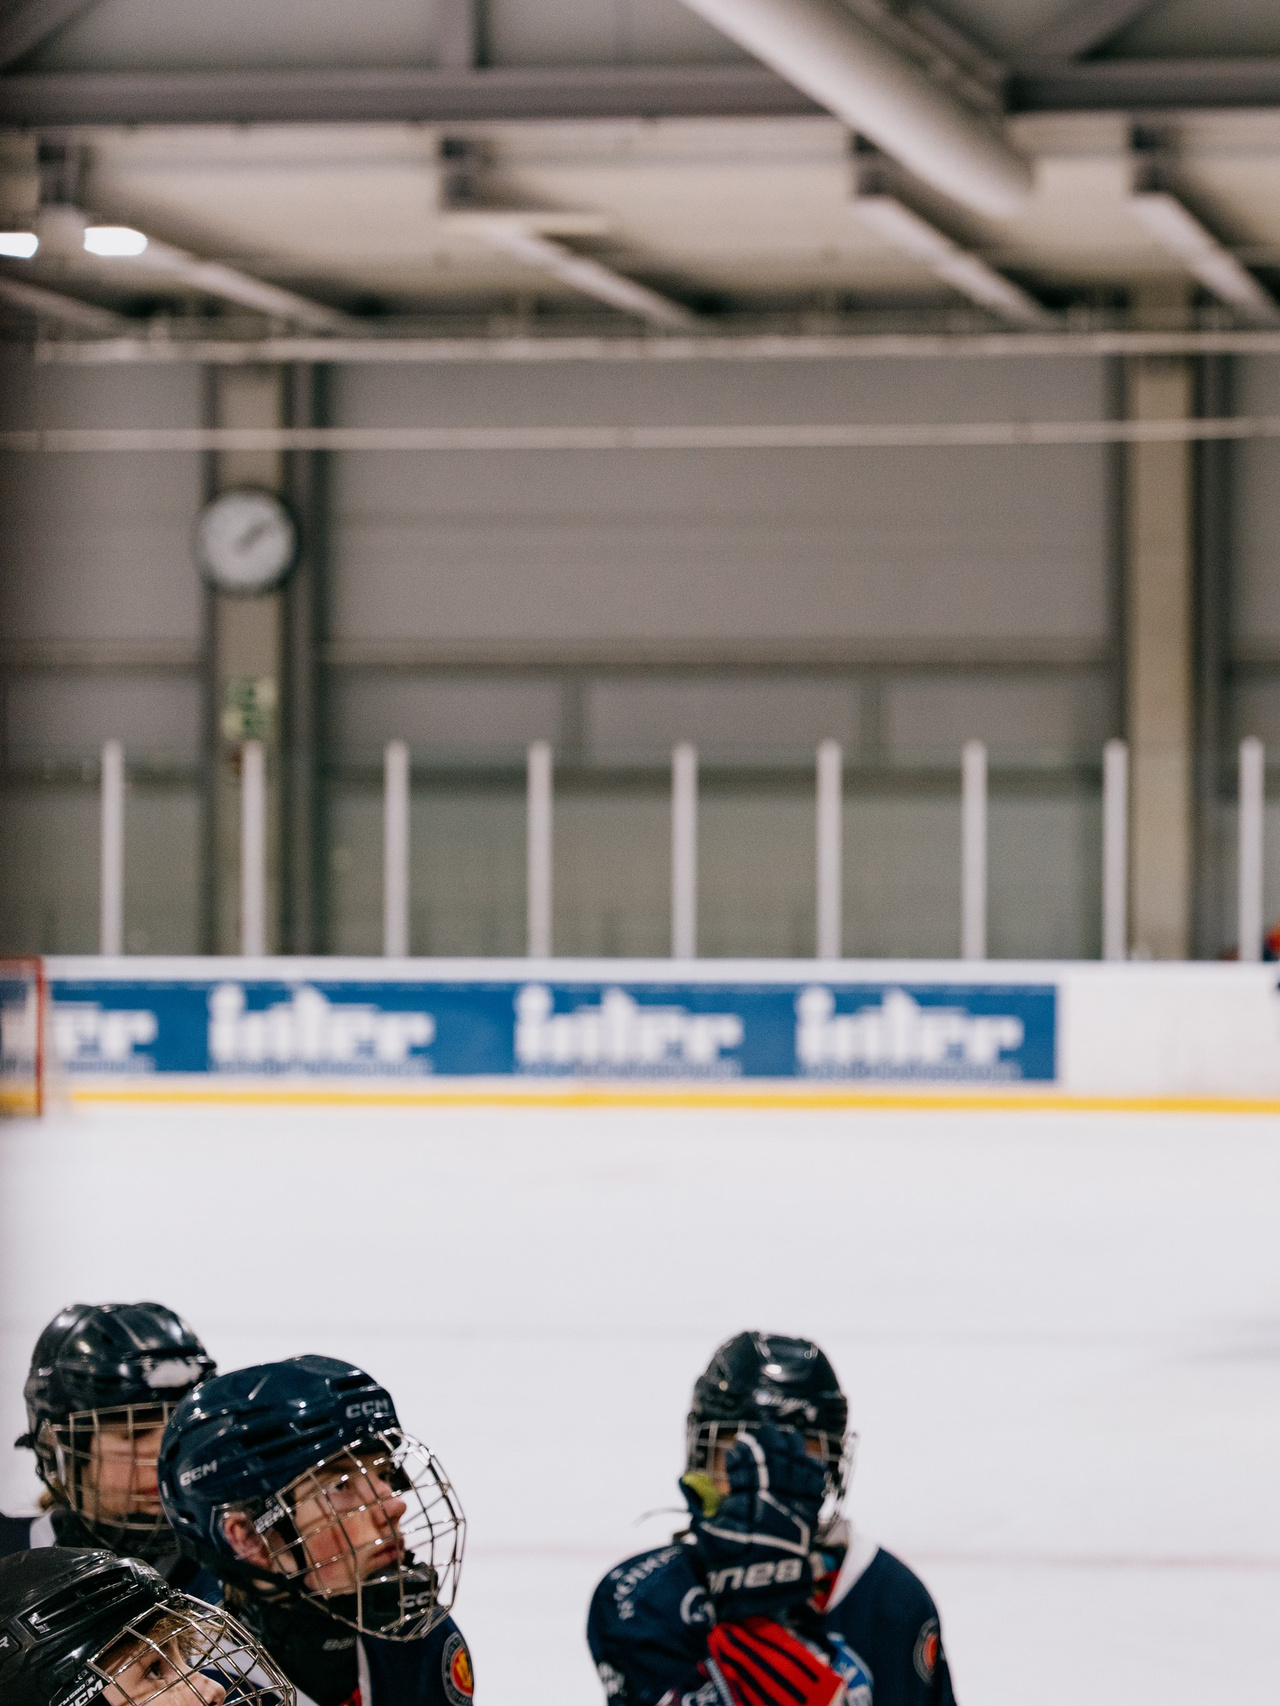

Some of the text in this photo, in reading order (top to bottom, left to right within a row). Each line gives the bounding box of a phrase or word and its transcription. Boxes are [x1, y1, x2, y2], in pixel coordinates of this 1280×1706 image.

[346, 1399, 389, 1419] CCM
[179, 1460, 217, 1487] CCM
[67, 1680, 103, 1706] CM
